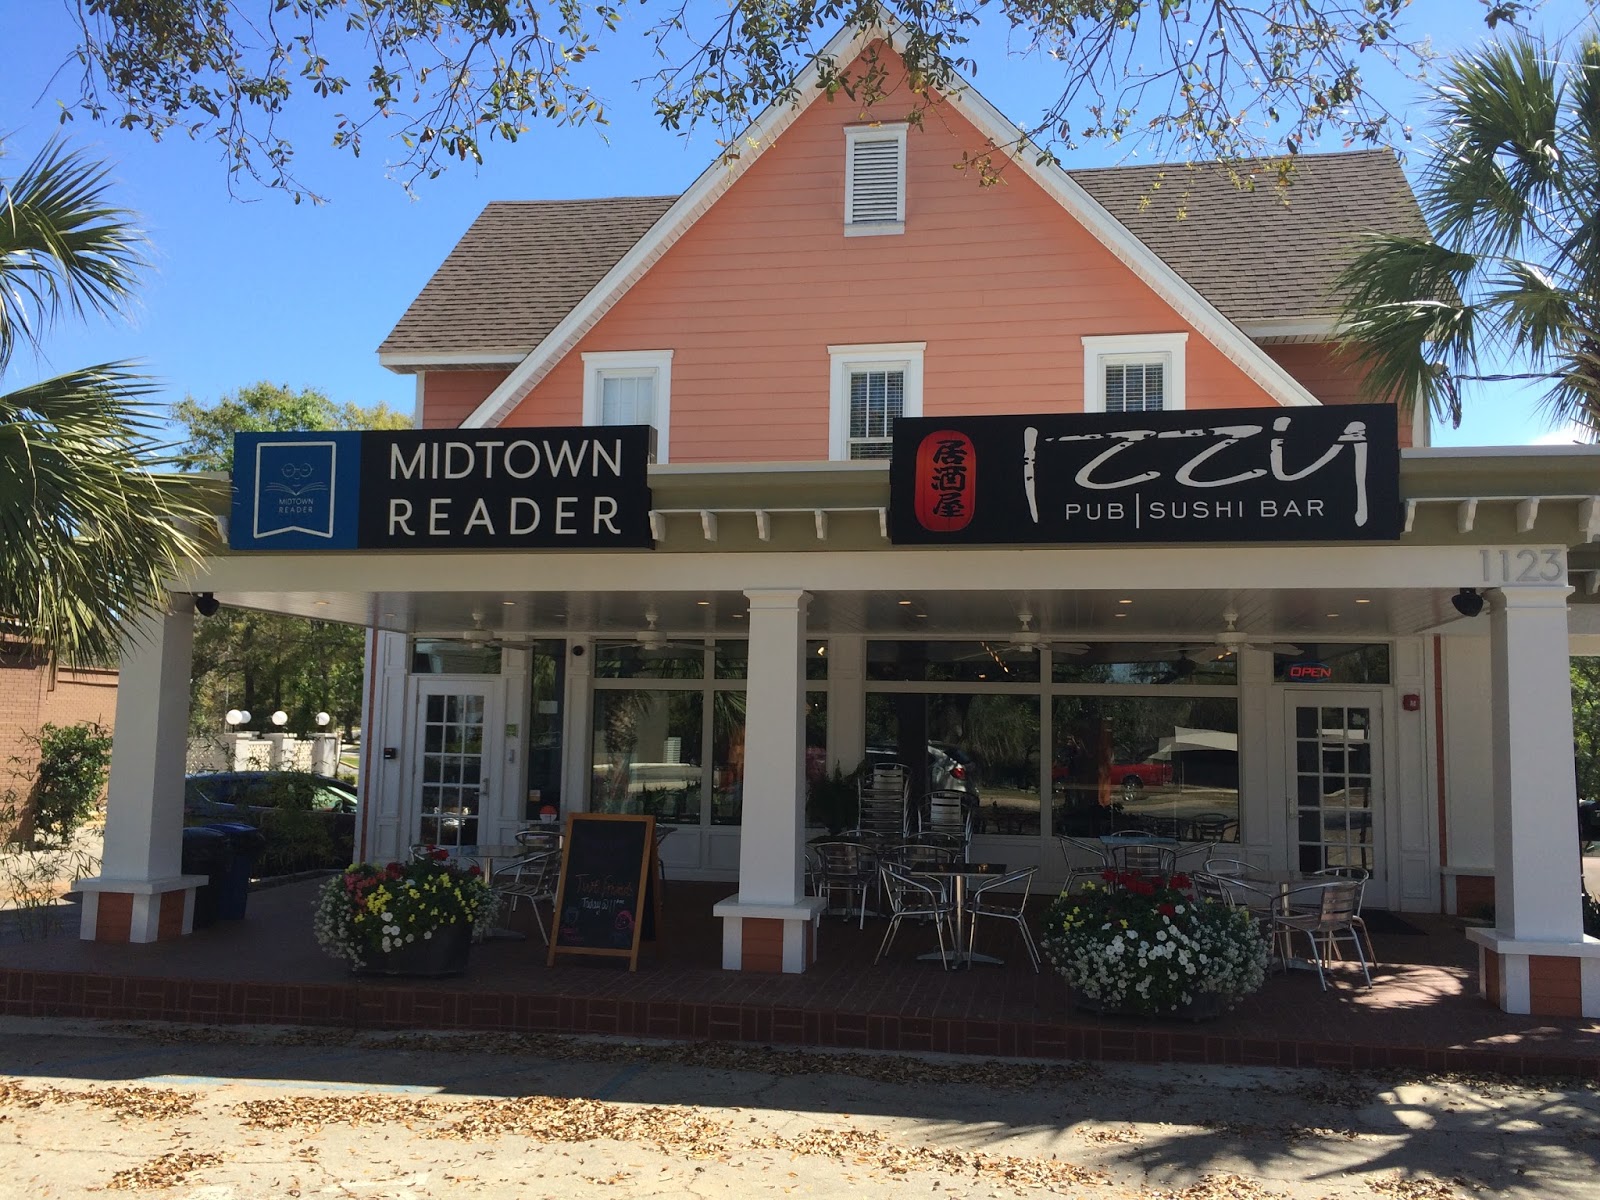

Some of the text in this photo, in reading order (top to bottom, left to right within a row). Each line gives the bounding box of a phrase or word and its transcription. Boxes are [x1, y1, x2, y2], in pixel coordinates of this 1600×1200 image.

[389, 439, 622, 480] MIDTOWN
[931, 440, 967, 517] 居酒屋
[278, 506, 313, 514] READER
[388, 496, 621, 536] READER
[1066, 500, 1324, 520] PUB SUSHI BAR
[1480, 549, 1563, 582] 1123
[1290, 666, 1332, 678] OPEN
